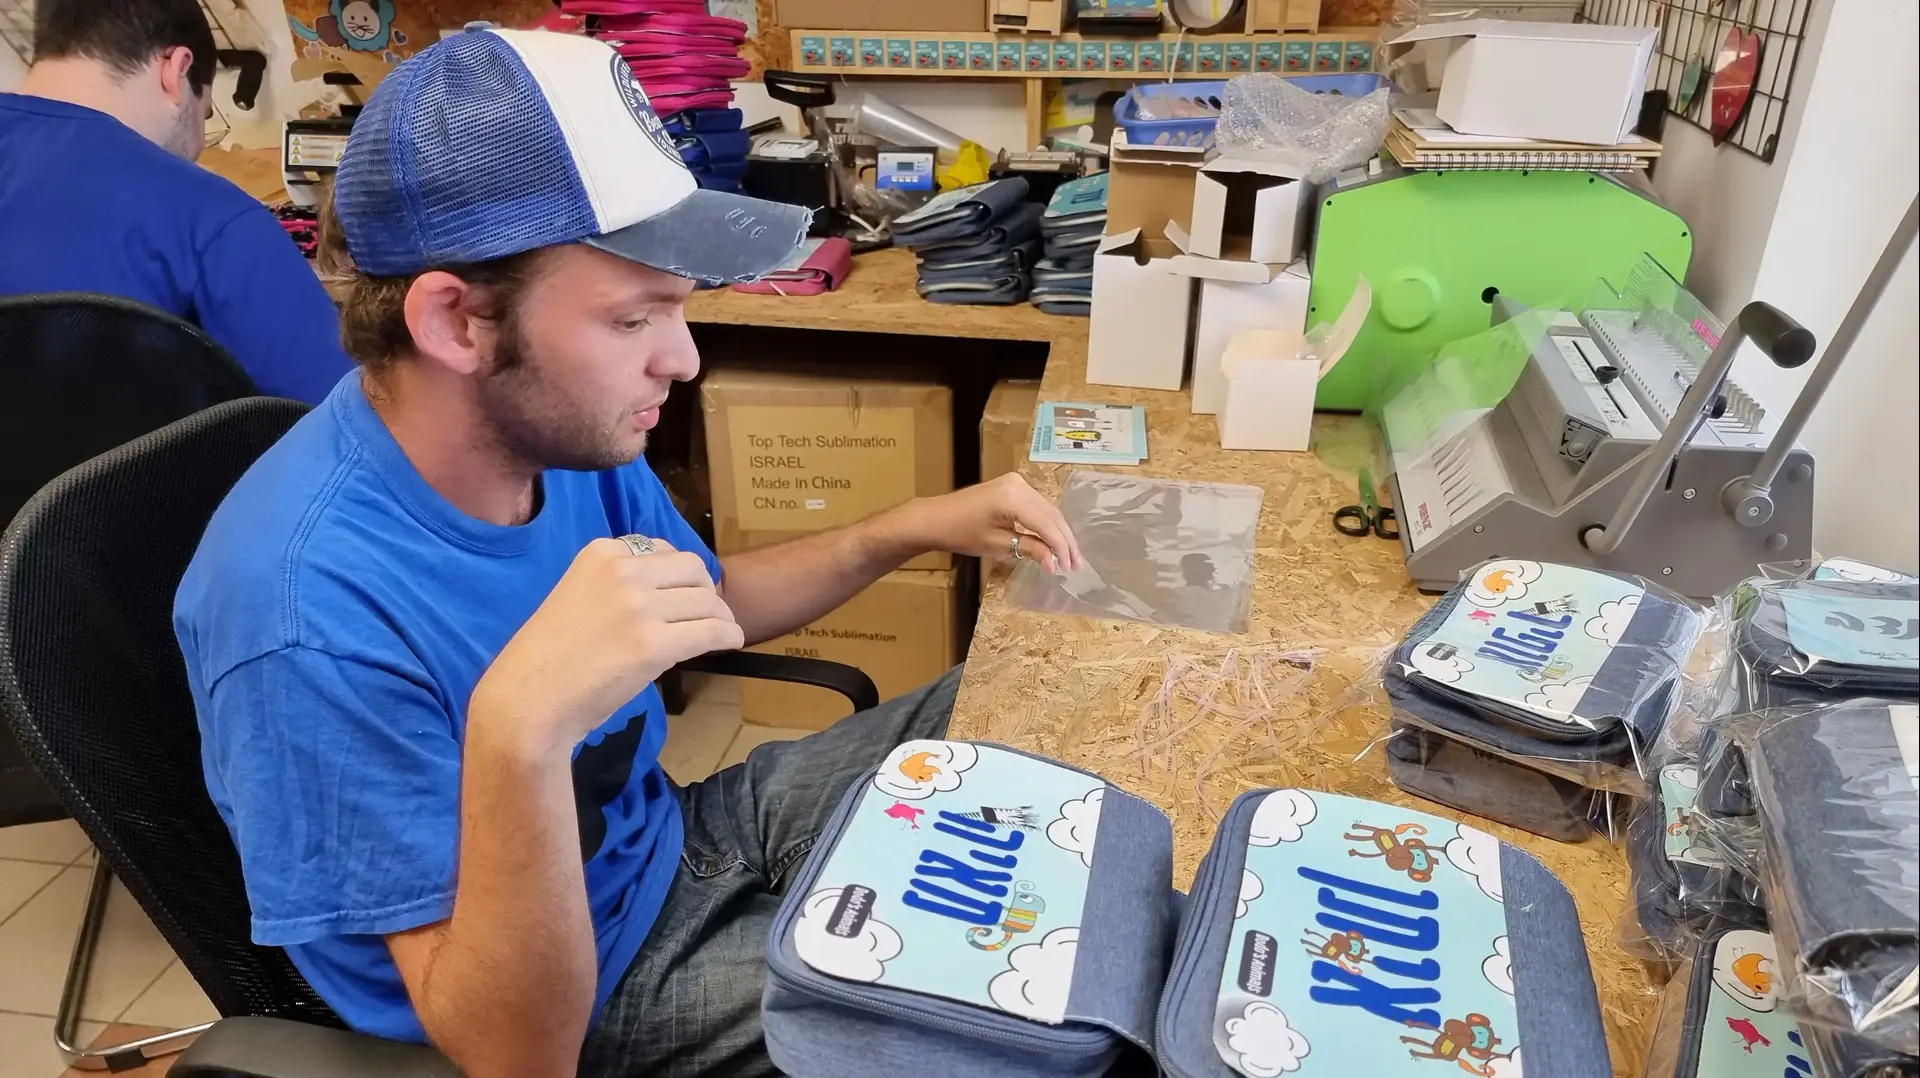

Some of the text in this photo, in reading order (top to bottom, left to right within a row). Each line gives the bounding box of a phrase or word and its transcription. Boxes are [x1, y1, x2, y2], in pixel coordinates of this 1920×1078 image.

[748, 435, 896, 450] Top Tech Sublimation
[750, 456, 805, 469] ISRAEL
[752, 476, 851, 489] Made In China
[804, 628, 828, 637] Tech
[831, 629, 898, 642] Sublimation
[785, 647, 819, 657] ISRAEL
[902, 810, 1025, 925] מאיה
[834, 908, 859, 937] Animals
[1297, 866, 1441, 1029] איתן
[1246, 933, 1270, 993] Dodo's Animals
